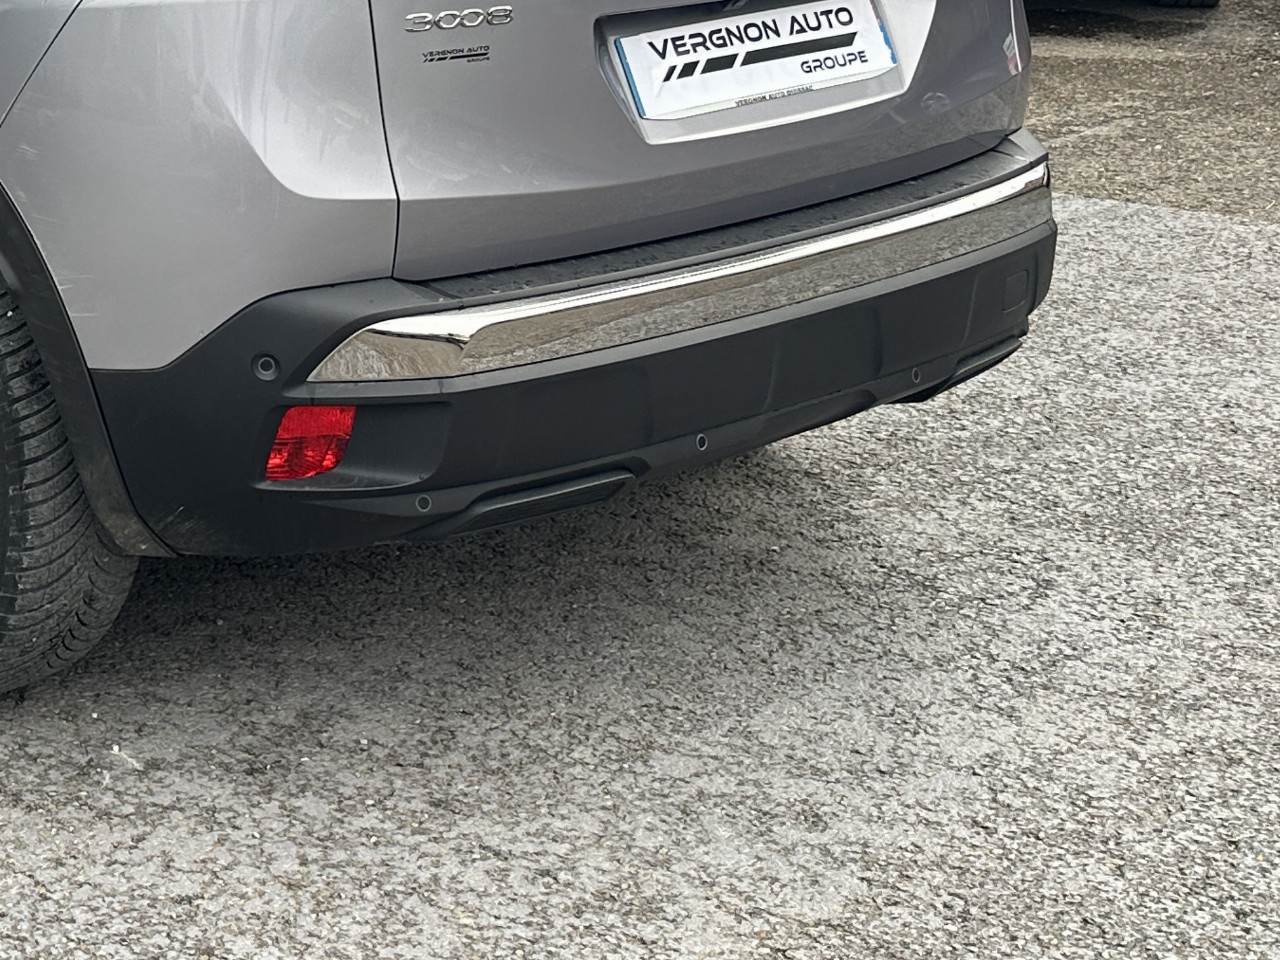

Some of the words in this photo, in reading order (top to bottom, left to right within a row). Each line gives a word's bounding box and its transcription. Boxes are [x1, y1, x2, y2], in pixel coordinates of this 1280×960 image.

[405, 5, 513, 32] 3008
[647, 19, 781, 61] VERGNON
[789, 6, 854, 37] AUTO
[800, 50, 869, 73] GROUPE
